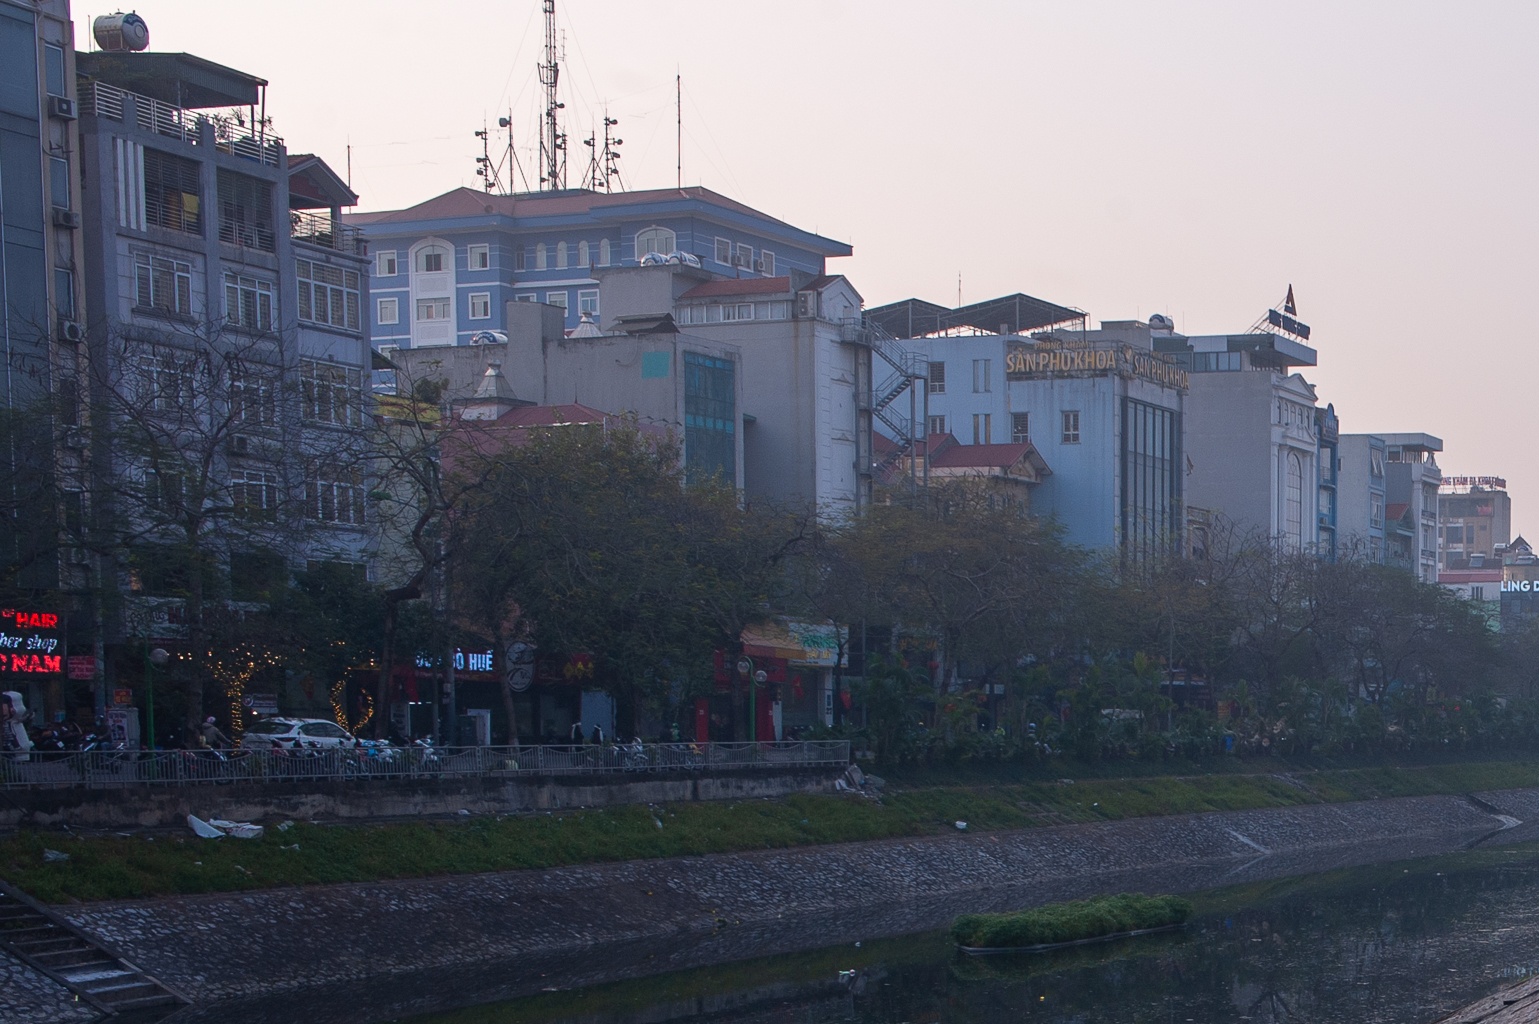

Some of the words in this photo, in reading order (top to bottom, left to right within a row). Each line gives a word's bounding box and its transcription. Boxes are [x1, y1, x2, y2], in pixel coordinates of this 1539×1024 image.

[1006, 347, 1036, 373] SẢN
[1074, 350, 1116, 372] KHOA
[1500, 580, 1531, 593] LING
[16, 612, 58, 629] HAIR
[26, 634, 58, 653] shop
[11, 653, 62, 672] NAM
[469, 649, 494, 672] HUẾ
